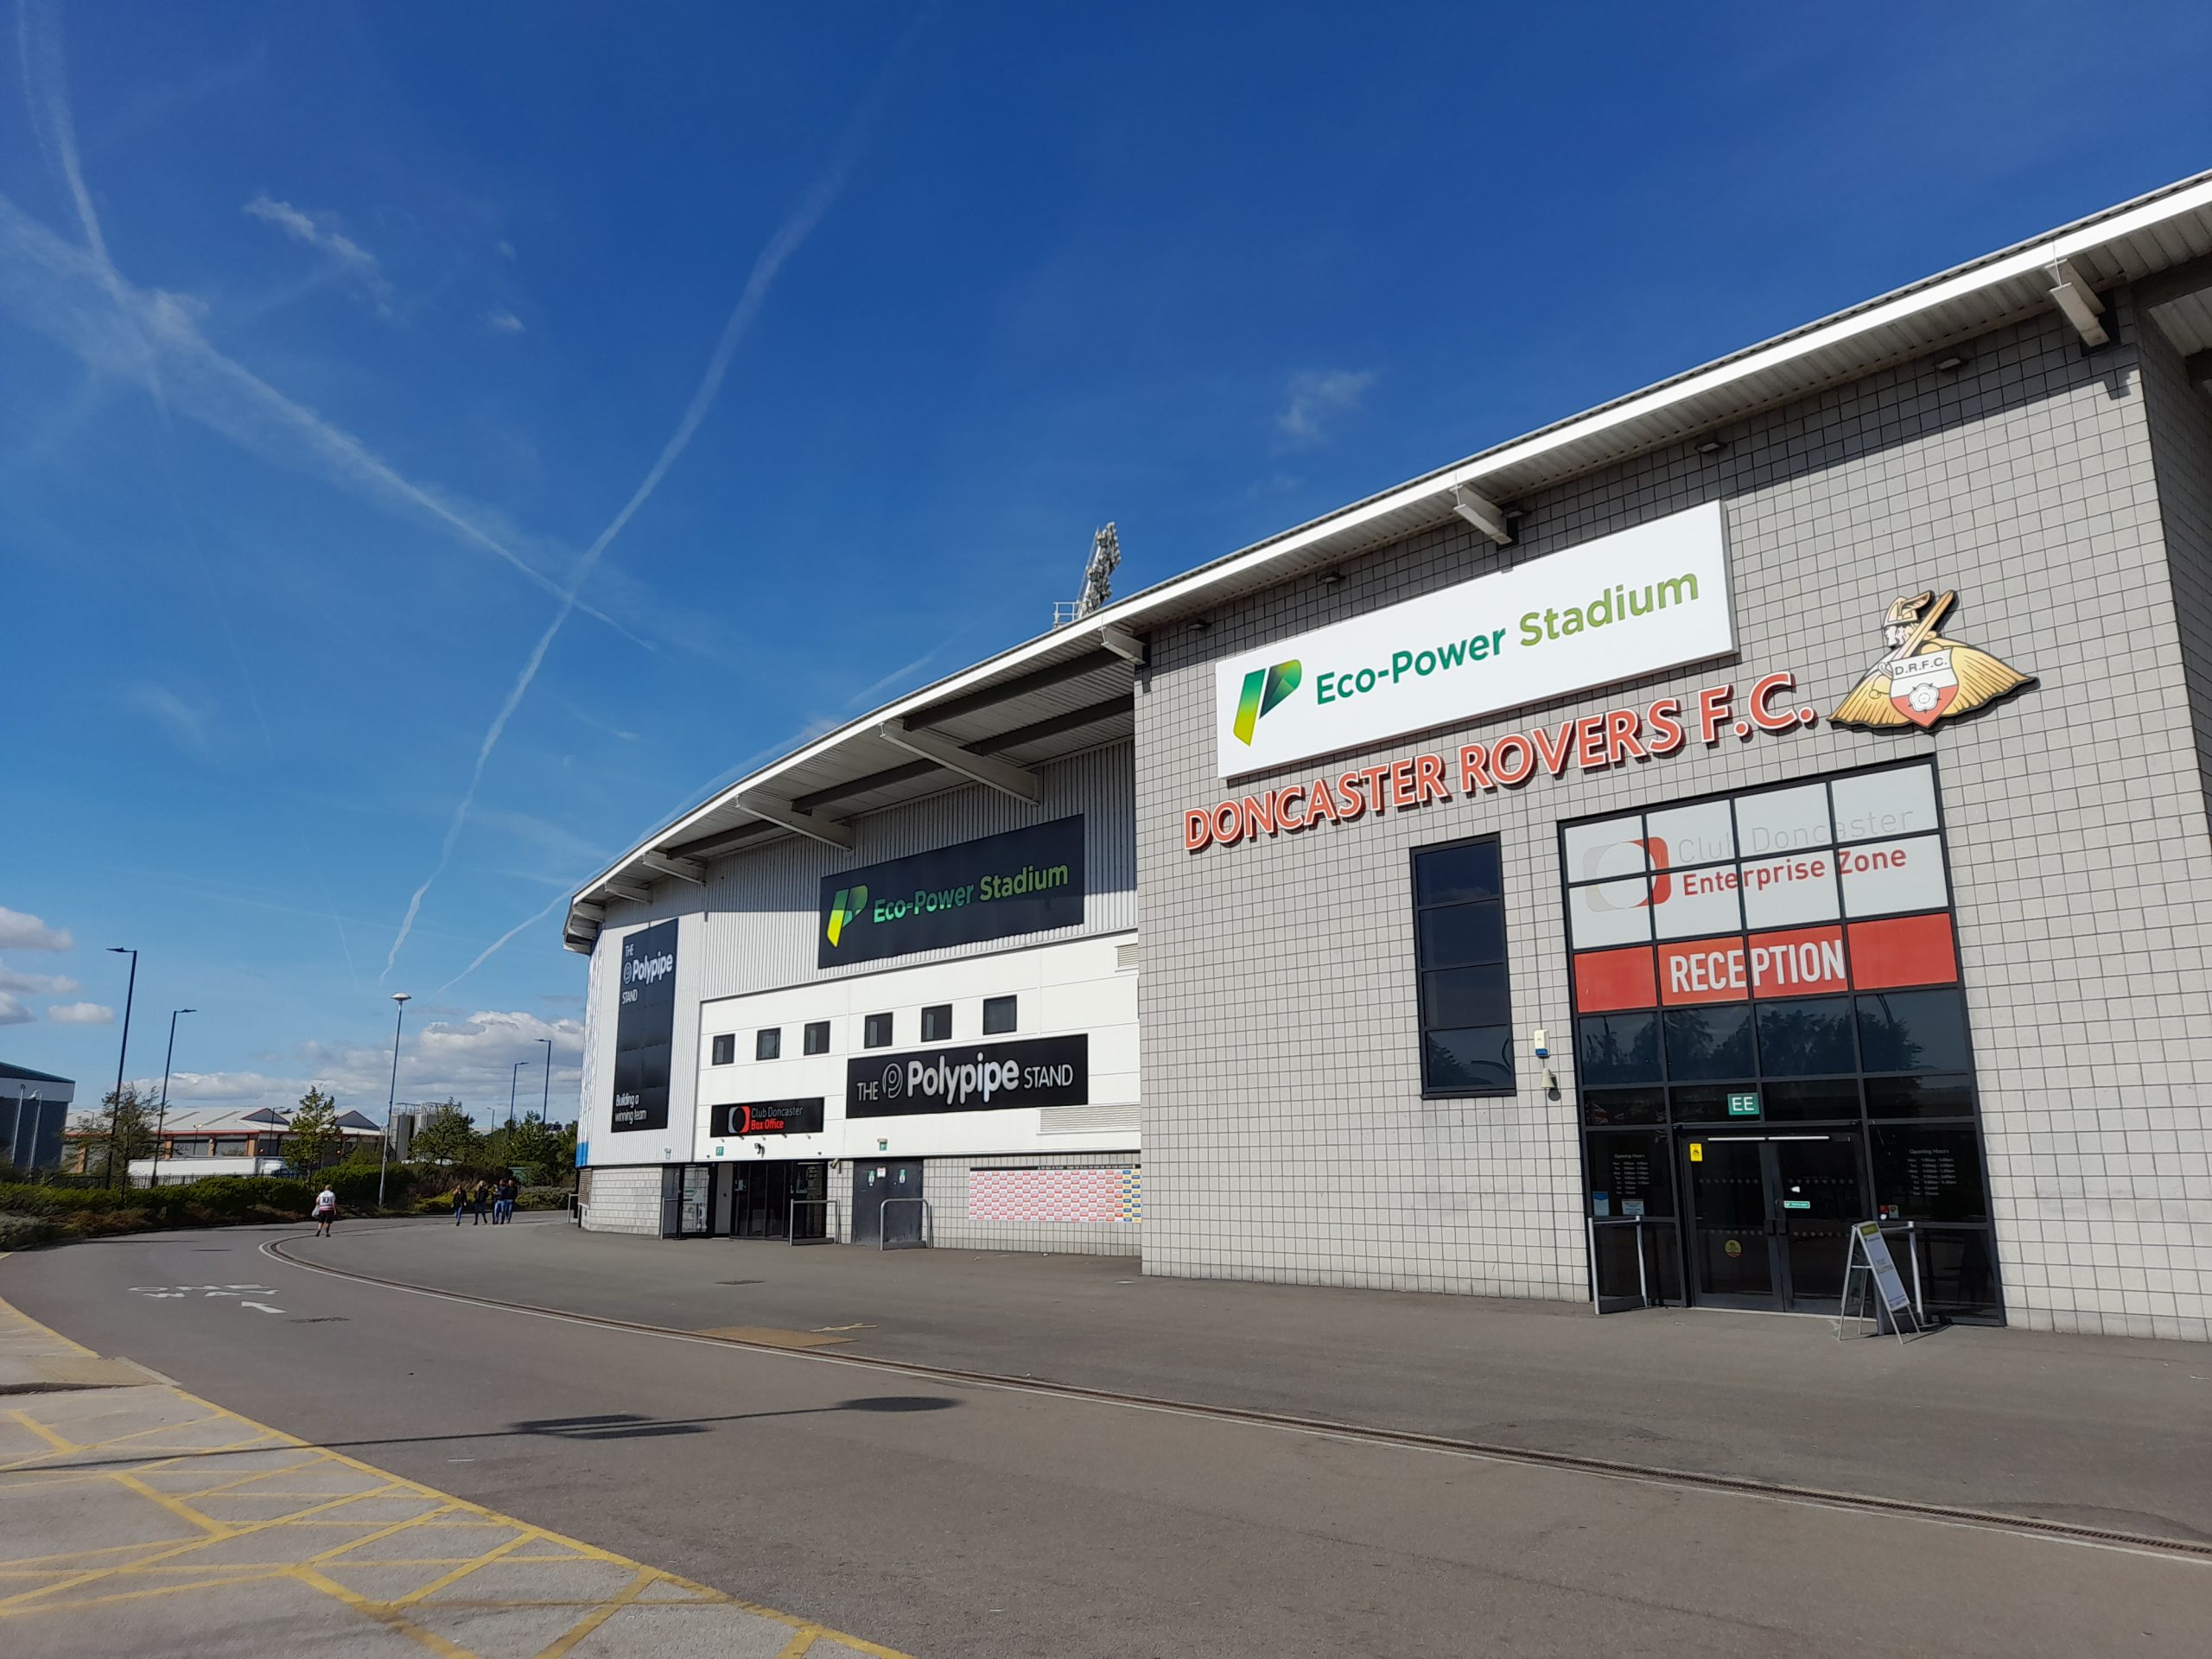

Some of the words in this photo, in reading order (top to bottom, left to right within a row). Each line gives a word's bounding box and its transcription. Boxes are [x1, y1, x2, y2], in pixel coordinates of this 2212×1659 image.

[1316, 627, 1506, 705] Eco-Power
[1520, 572, 1699, 647] Stadium
[1895, 657, 1948, 676] D.R.F.C.
[1184, 753, 1450, 852] DONCASTER
[1459, 697, 1684, 793] ROVERS
[1698, 671, 1816, 743] F.C.
[1752, 810, 1913, 853] Doncaster
[1683, 859, 1825, 896] Enterprise
[1839, 849, 1907, 875] Zone
[873, 884, 975, 924] Eco-Power
[979, 864, 1069, 901] Stadium
[625, 944, 634, 957] THE
[632, 950, 673, 985] Polypipe
[1670, 938, 1846, 995] RECEPTION
[621, 988, 638, 1004] STAND
[856, 1081, 879, 1101] THE
[907, 1052, 1020, 1105] Polypipe
[1024, 1064, 1073, 1090] STAND
[615, 1092, 634, 1108] Building
[1732, 1096, 1755, 1111] EE
[614, 1109, 633, 1124] winning
[633, 1109, 647, 1121] team
[751, 1107, 766, 1119] Club
[767, 1105, 804, 1117] Doncaster
[751, 1120, 763, 1130] Box
[764, 1118, 785, 1129] Office
[143, 1289, 279, 1298] WAY
